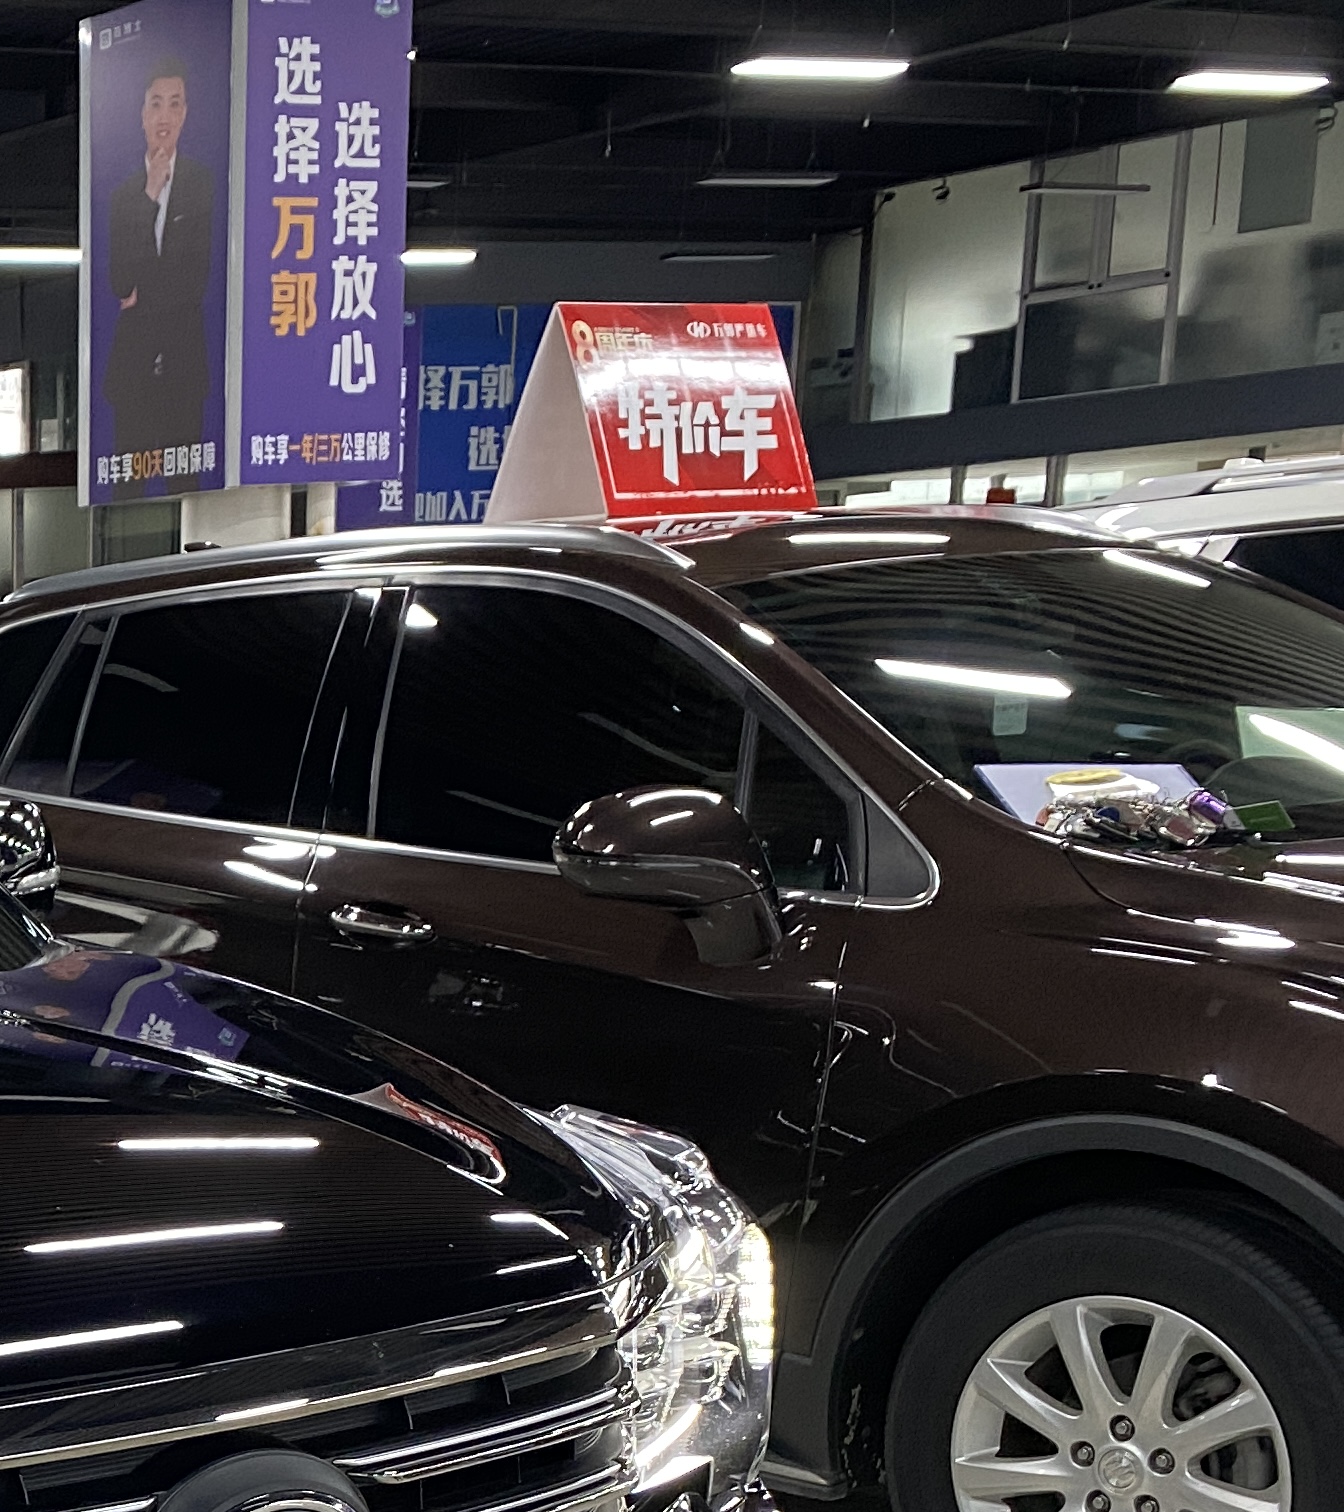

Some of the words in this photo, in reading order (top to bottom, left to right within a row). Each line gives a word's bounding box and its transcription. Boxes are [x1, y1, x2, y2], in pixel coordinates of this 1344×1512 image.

[269, 36, 322, 337] 选择万郭
[329, 100, 381, 394] 选择放心
[96, 441, 216, 485] 购车享90天回购保障
[616, 381, 779, 487] 特价车
